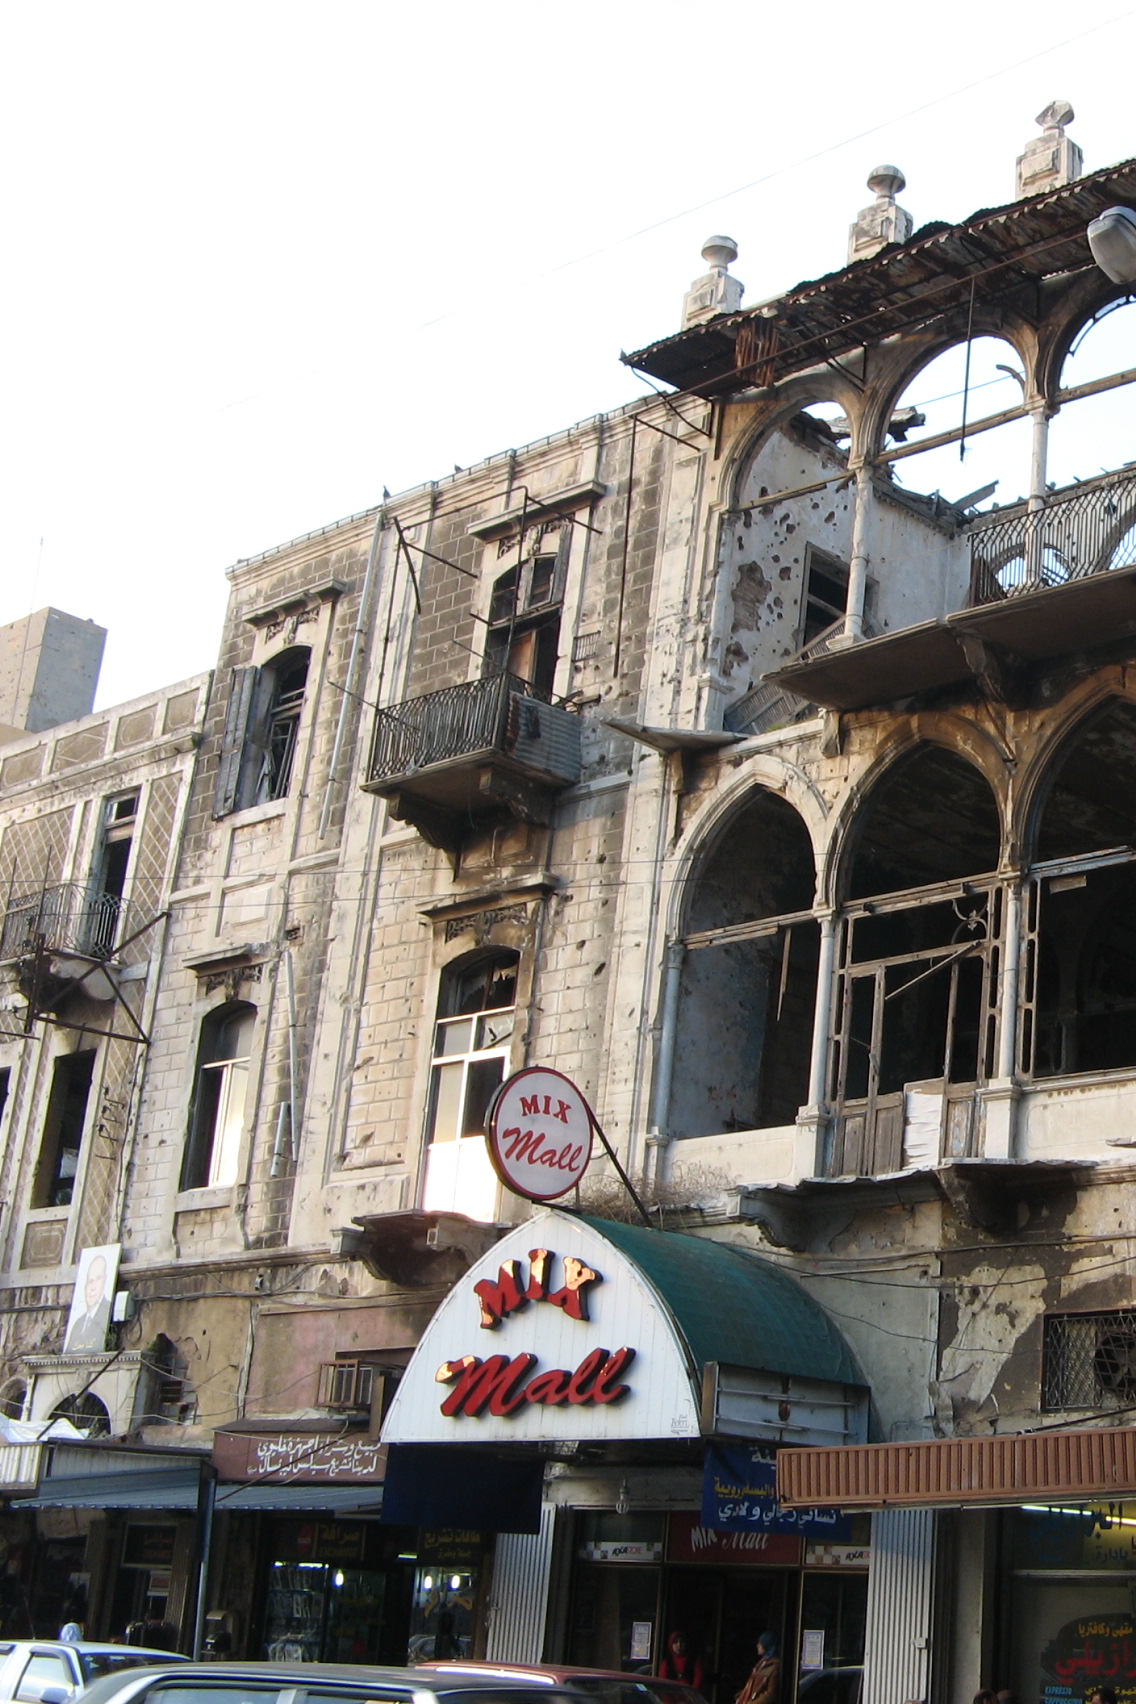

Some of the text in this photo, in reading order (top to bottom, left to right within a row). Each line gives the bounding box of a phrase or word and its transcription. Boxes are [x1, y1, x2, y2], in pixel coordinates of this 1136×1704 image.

[520, 1094, 572, 1124] MIX
[501, 1126, 584, 1172] Mall
[473, 1248, 602, 1329] MIX
[434, 1345, 637, 1418] Mall
